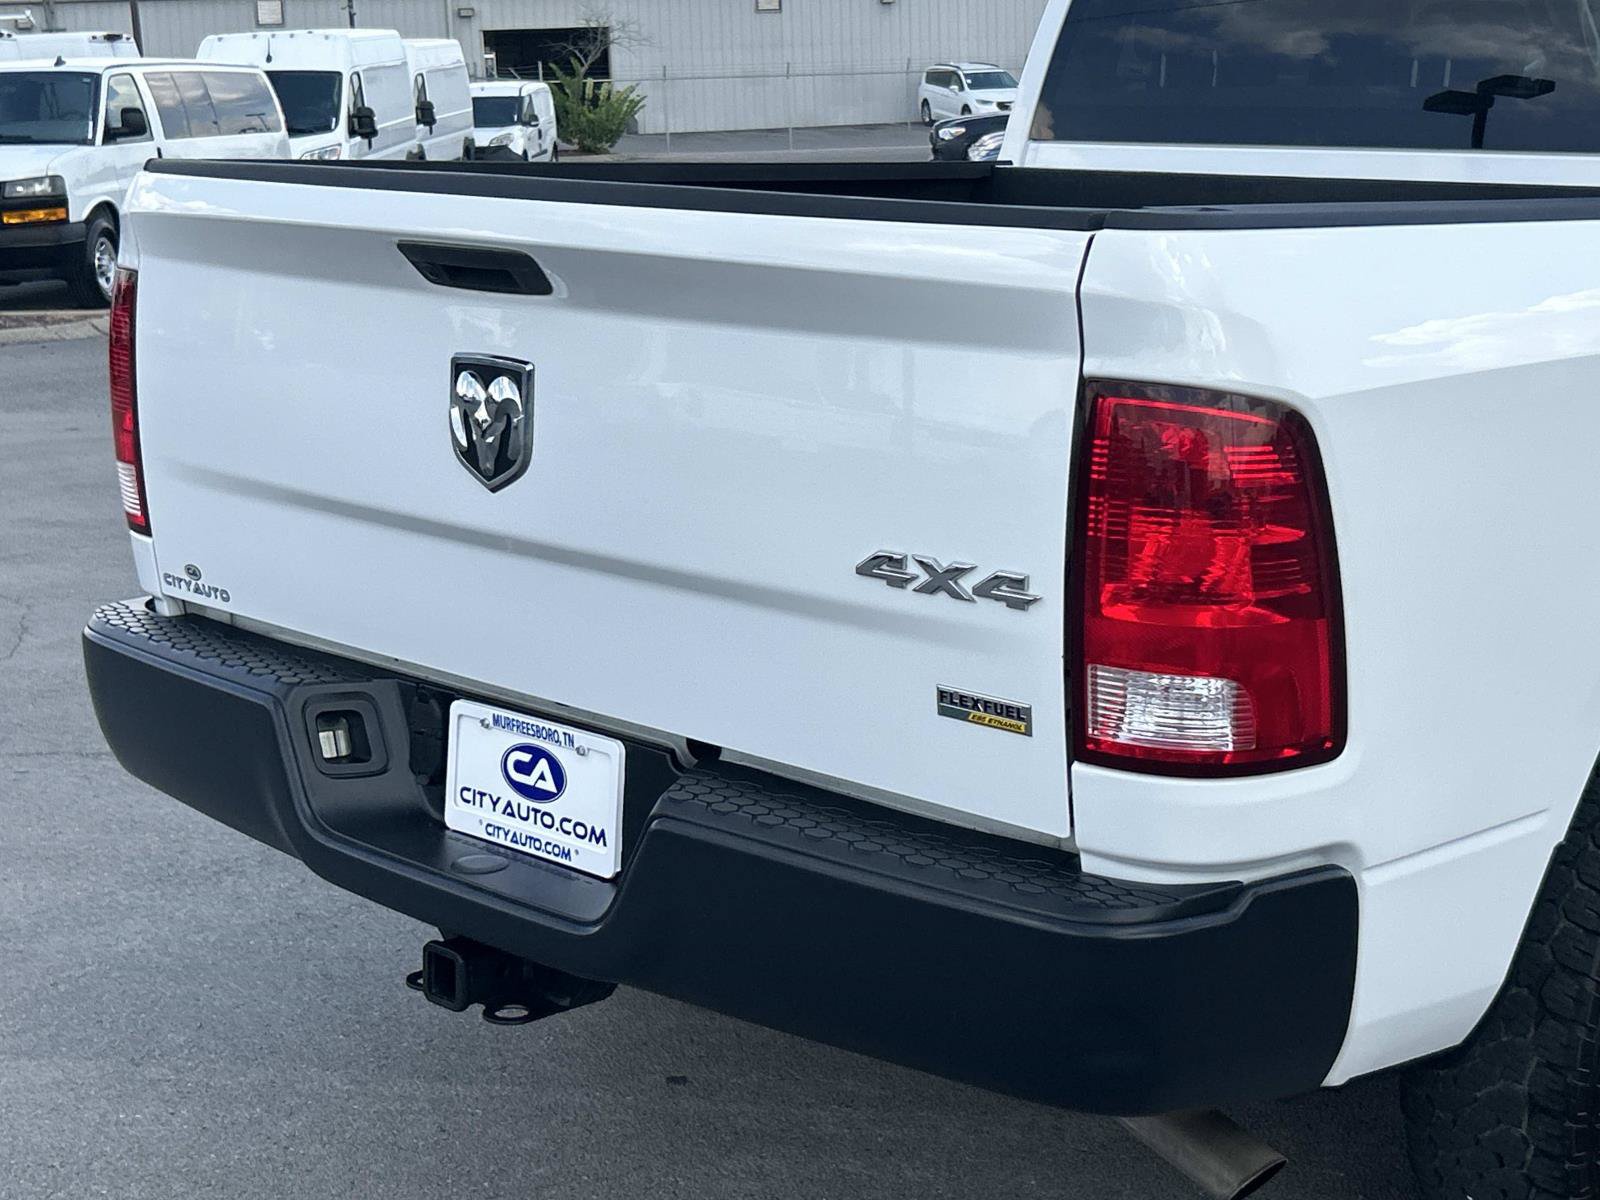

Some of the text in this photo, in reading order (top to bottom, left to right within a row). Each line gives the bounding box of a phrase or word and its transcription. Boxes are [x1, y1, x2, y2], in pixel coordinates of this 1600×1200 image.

[855, 549, 1043, 612] 4X4
[492, 713, 575, 749] MURFREESBORO, TN
